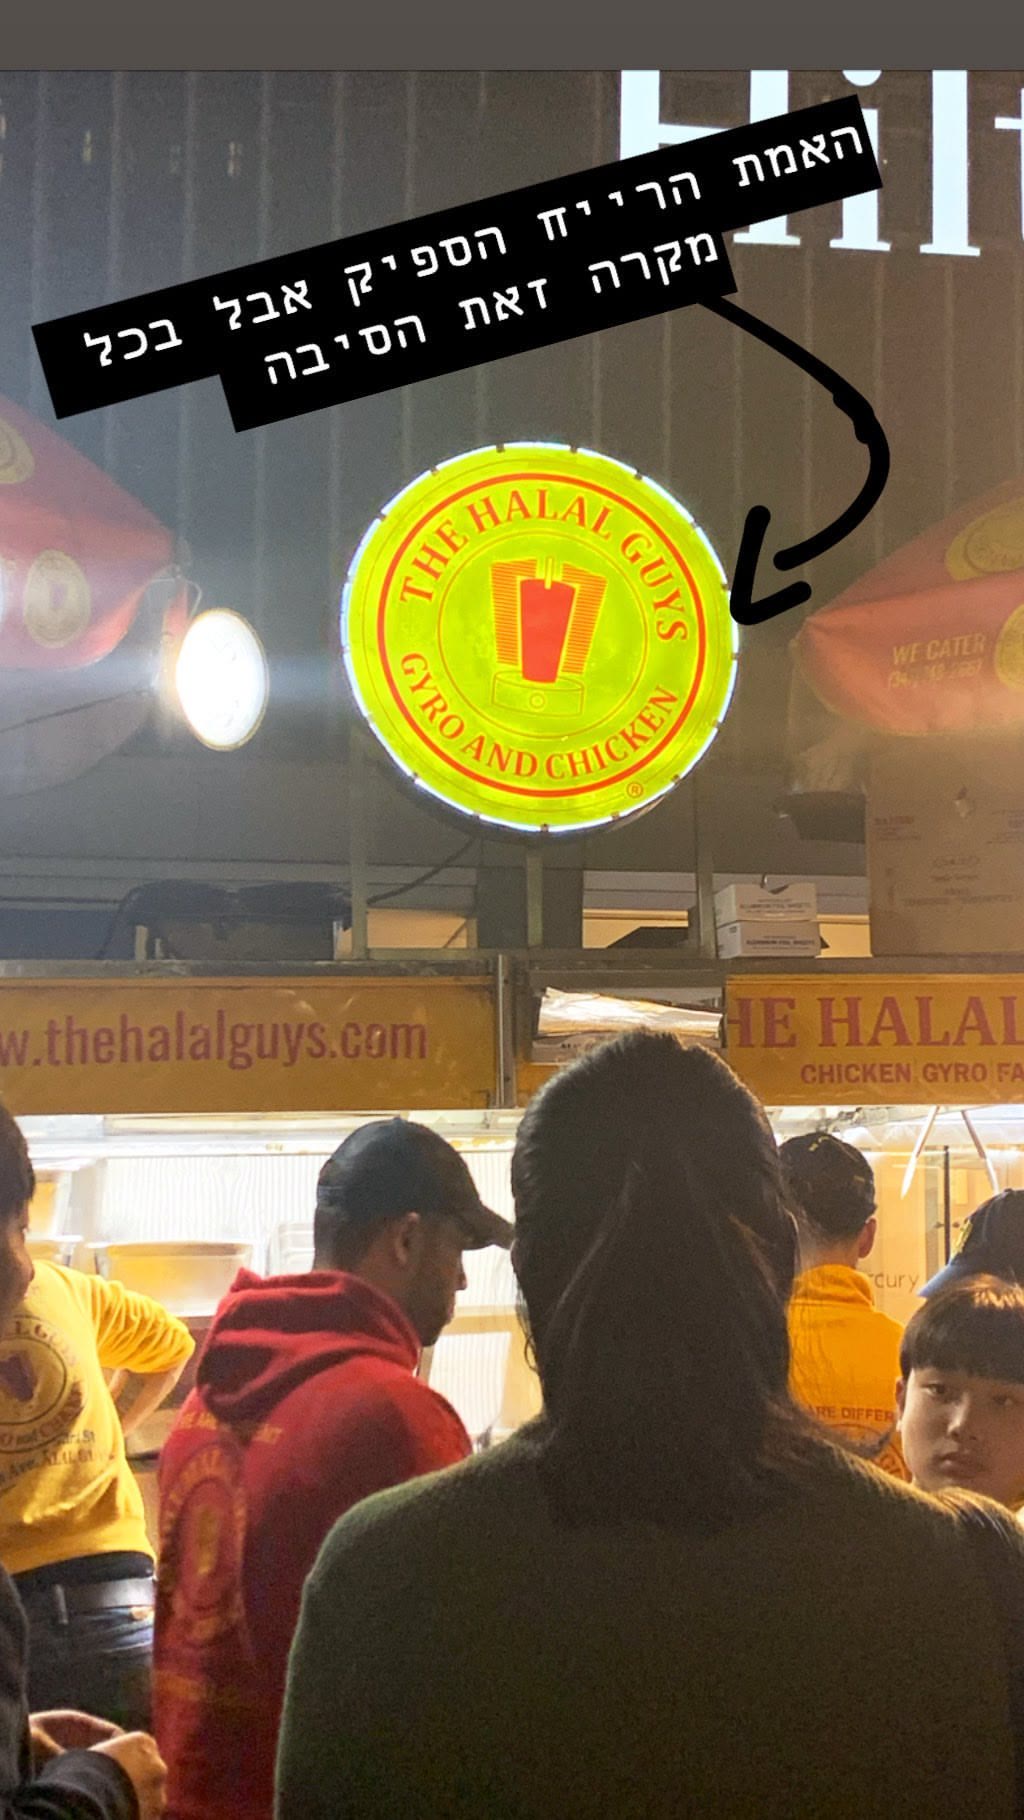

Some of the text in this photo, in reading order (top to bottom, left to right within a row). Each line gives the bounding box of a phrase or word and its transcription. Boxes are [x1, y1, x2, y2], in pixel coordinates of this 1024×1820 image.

[399, 488, 688, 642] THE HALAL GUYS
[401, 652, 679, 779] GYRO AND CHICKEN
[817, 996, 1024, 1047] HALAL
[801, 1063, 912, 1084] CHICKEN
[922, 1063, 988, 1084] GYRO
